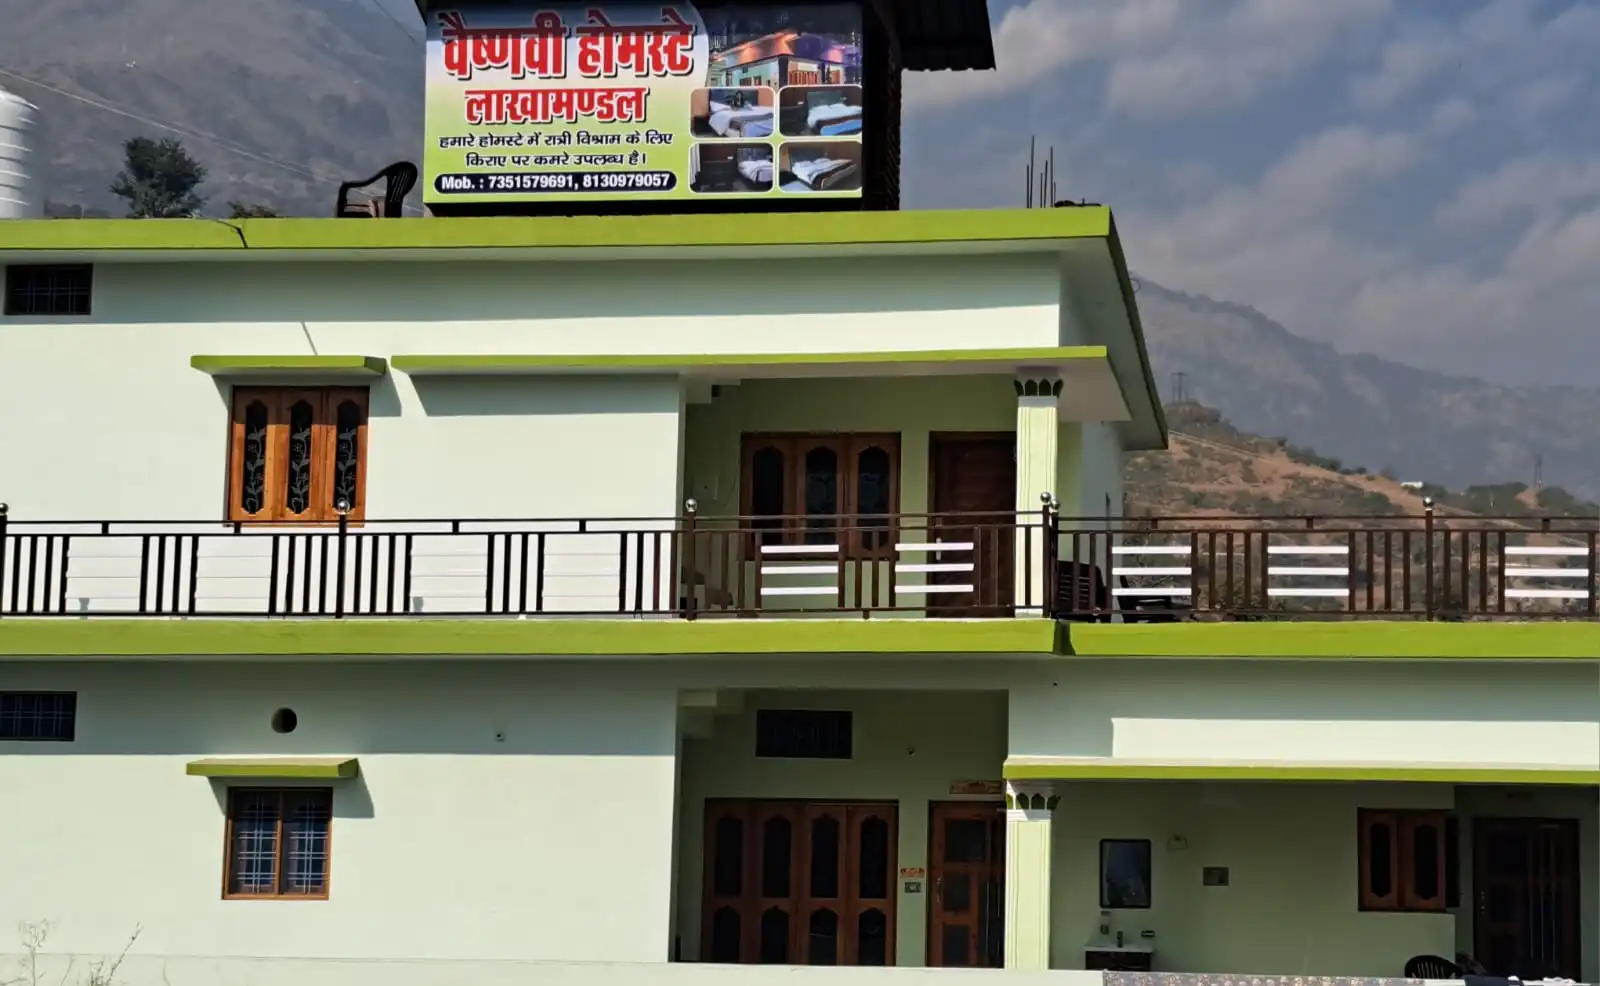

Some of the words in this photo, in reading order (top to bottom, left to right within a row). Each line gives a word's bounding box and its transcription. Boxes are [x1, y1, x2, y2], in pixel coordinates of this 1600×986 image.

[436, 10, 570, 79] वैष्णवी
[576, 8, 695, 77] होमस्टे
[465, 87, 649, 124] लाखामण्डल
[439, 133, 476, 148] हमारे
[479, 132, 523, 147] होमस्टे
[527, 131, 542, 146] में
[544, 131, 571, 146] रात्री
[577, 130, 620, 145] विश्राम
[625, 130, 641, 145] के
[645, 130, 672, 144] लिए
[466, 151, 506, 166] किराए
[512, 154, 530, 166] पर
[533, 152, 570, 166] कमरे
[574, 152, 623, 165] उपलब्ध
[441, 176, 475, 189] Mob.
[488, 175, 578, 190] 7351579691,
[583, 174, 669, 188] 8130979057
